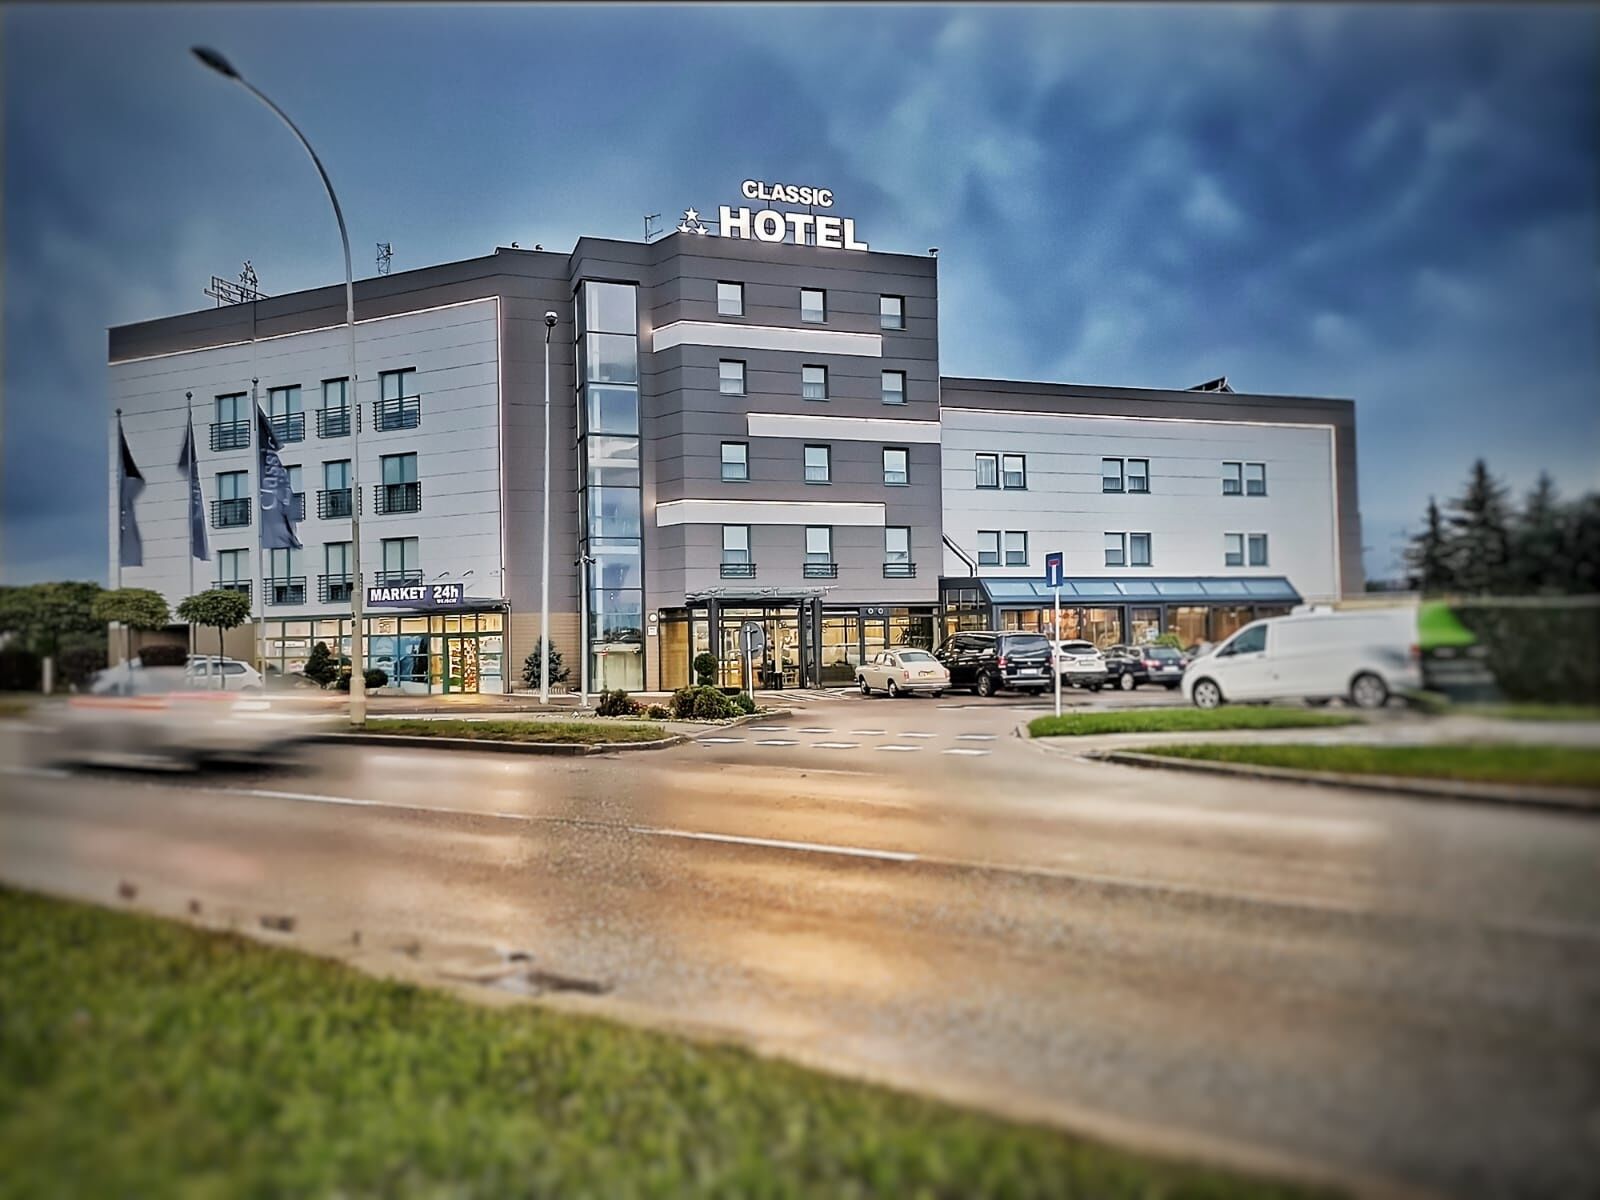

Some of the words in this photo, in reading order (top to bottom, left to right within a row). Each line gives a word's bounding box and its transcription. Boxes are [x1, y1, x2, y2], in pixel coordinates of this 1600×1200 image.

[741, 179, 834, 207] CLASSIC
[719, 205, 869, 251] HOTEL
[370, 586, 427, 602] MARKET
[433, 585, 459, 599] 24h
